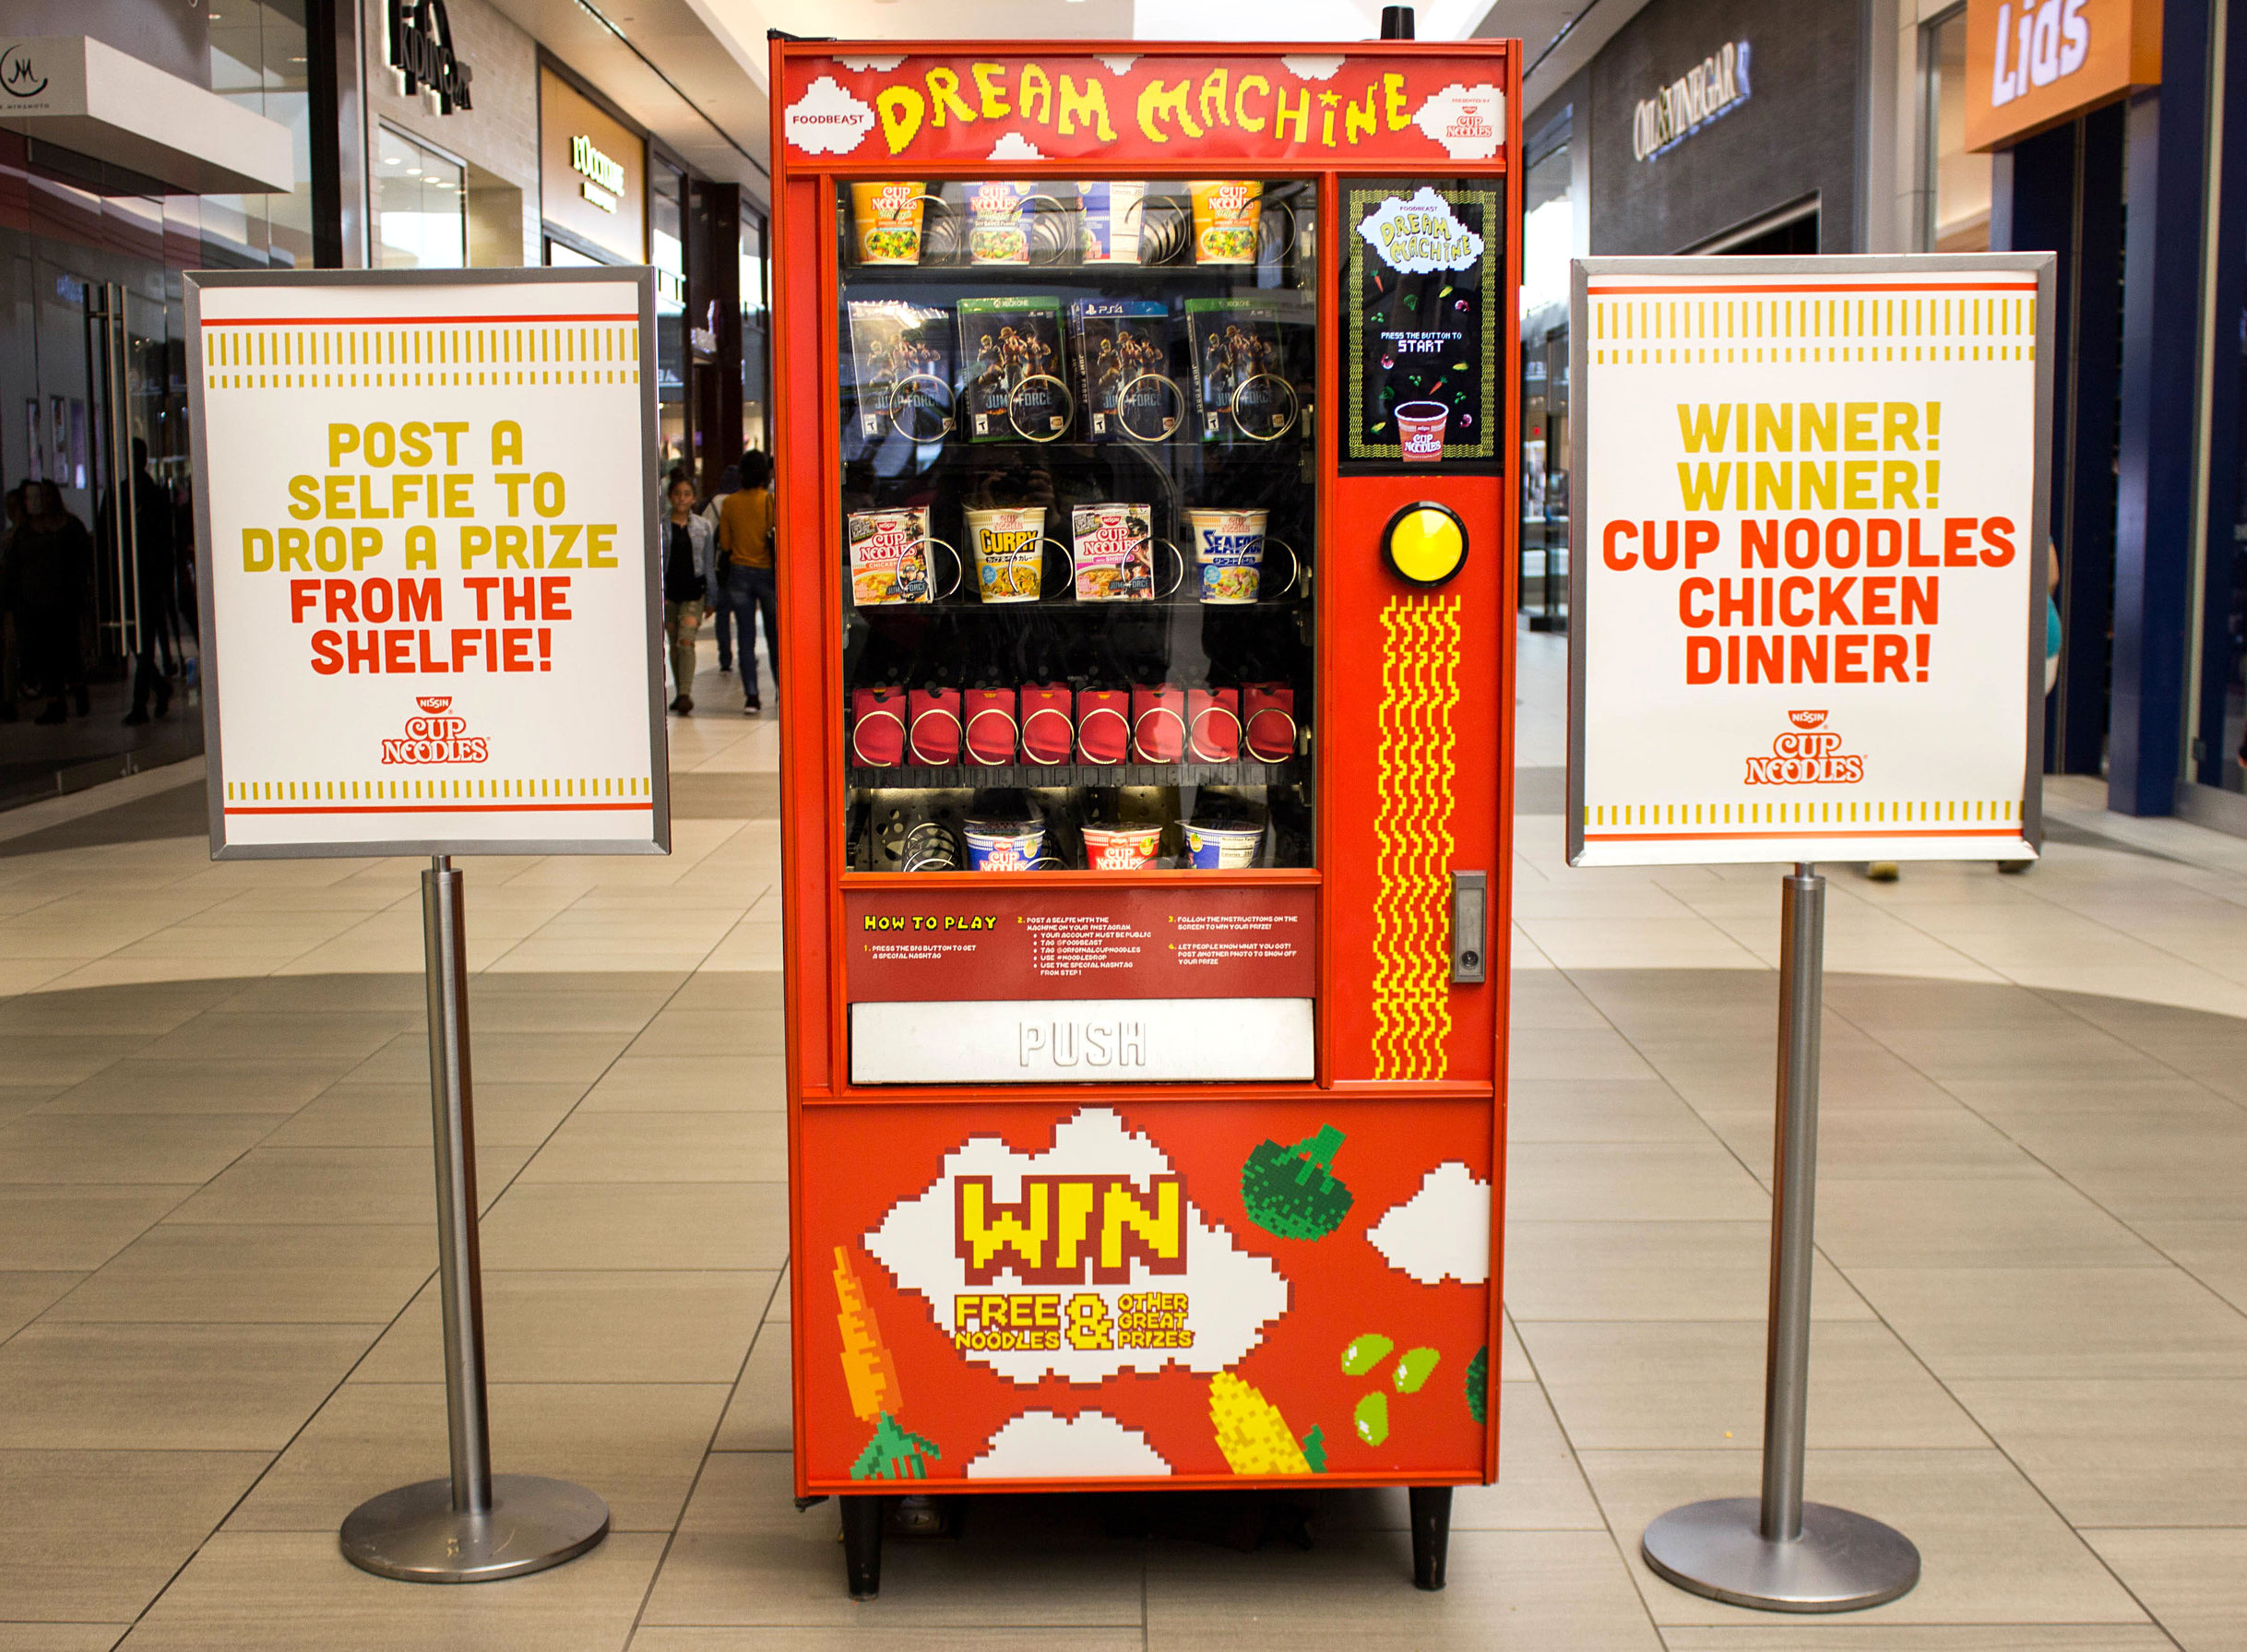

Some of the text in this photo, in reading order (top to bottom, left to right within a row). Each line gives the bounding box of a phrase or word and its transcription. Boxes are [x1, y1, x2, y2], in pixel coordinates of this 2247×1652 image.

[875, 63, 1119, 155] DREAM
[792, 114, 864, 126] FOODBEAST
[1456, 115, 1483, 127] CUP
[1446, 125, 1492, 137] NOODLES
[883, 186, 911, 198] CUP
[979, 184, 1011, 197] CUP
[1219, 186, 1247, 198] CUP
[1380, 213, 1451, 246] DREAM
[1099, 305, 1124, 314] PS4
[1397, 339, 1444, 352] START
[1676, 401, 1941, 453] WINNER!
[327, 420, 523, 468] POST A
[1404, 440, 1441, 453] NOODLES
[1412, 434, 1433, 444] CUP
[1676, 459, 1941, 512] WINNER!
[287, 471, 565, 521] SELFIE TO
[872, 532, 907, 547] CUP
[980, 529, 1039, 555] CURRY
[1096, 527, 1130, 541] CUP
[1602, 516, 2016, 572] CUP NOODLES
[242, 523, 618, 572] DROP A PRIZE
[1084, 539, 1141, 555] NOODLES
[290, 576, 572, 624] FROM THE
[1678, 575, 1938, 628] CHICKEN
[310, 628, 552, 675] SHELFIE!
[1685, 633, 1931, 685] DINNER!
[420, 698, 448, 708] NISSIN
[1792, 712, 1825, 723] NISSIN
[405, 717, 467, 741] CUP
[381, 737, 489, 765] NOODLES
[1773, 731, 1842, 759] CUP
[1744, 755, 1864, 785] NOODLES
[988, 850, 1020, 864] CUP
[1105, 848, 1135, 860] CUP
[863, 915, 997, 932] HOW TO PLAY
[1019, 1021, 1146, 1067] PUSH
[961, 1180, 1182, 1271] WIN
[1118, 1291, 1189, 1312] OTHER
[955, 1293, 1114, 1350] FREE &
[1118, 1312, 1189, 1331] GREAT
[955, 1331, 1061, 1350] NOODLES
[1117, 1331, 1195, 1349] PRIZES
